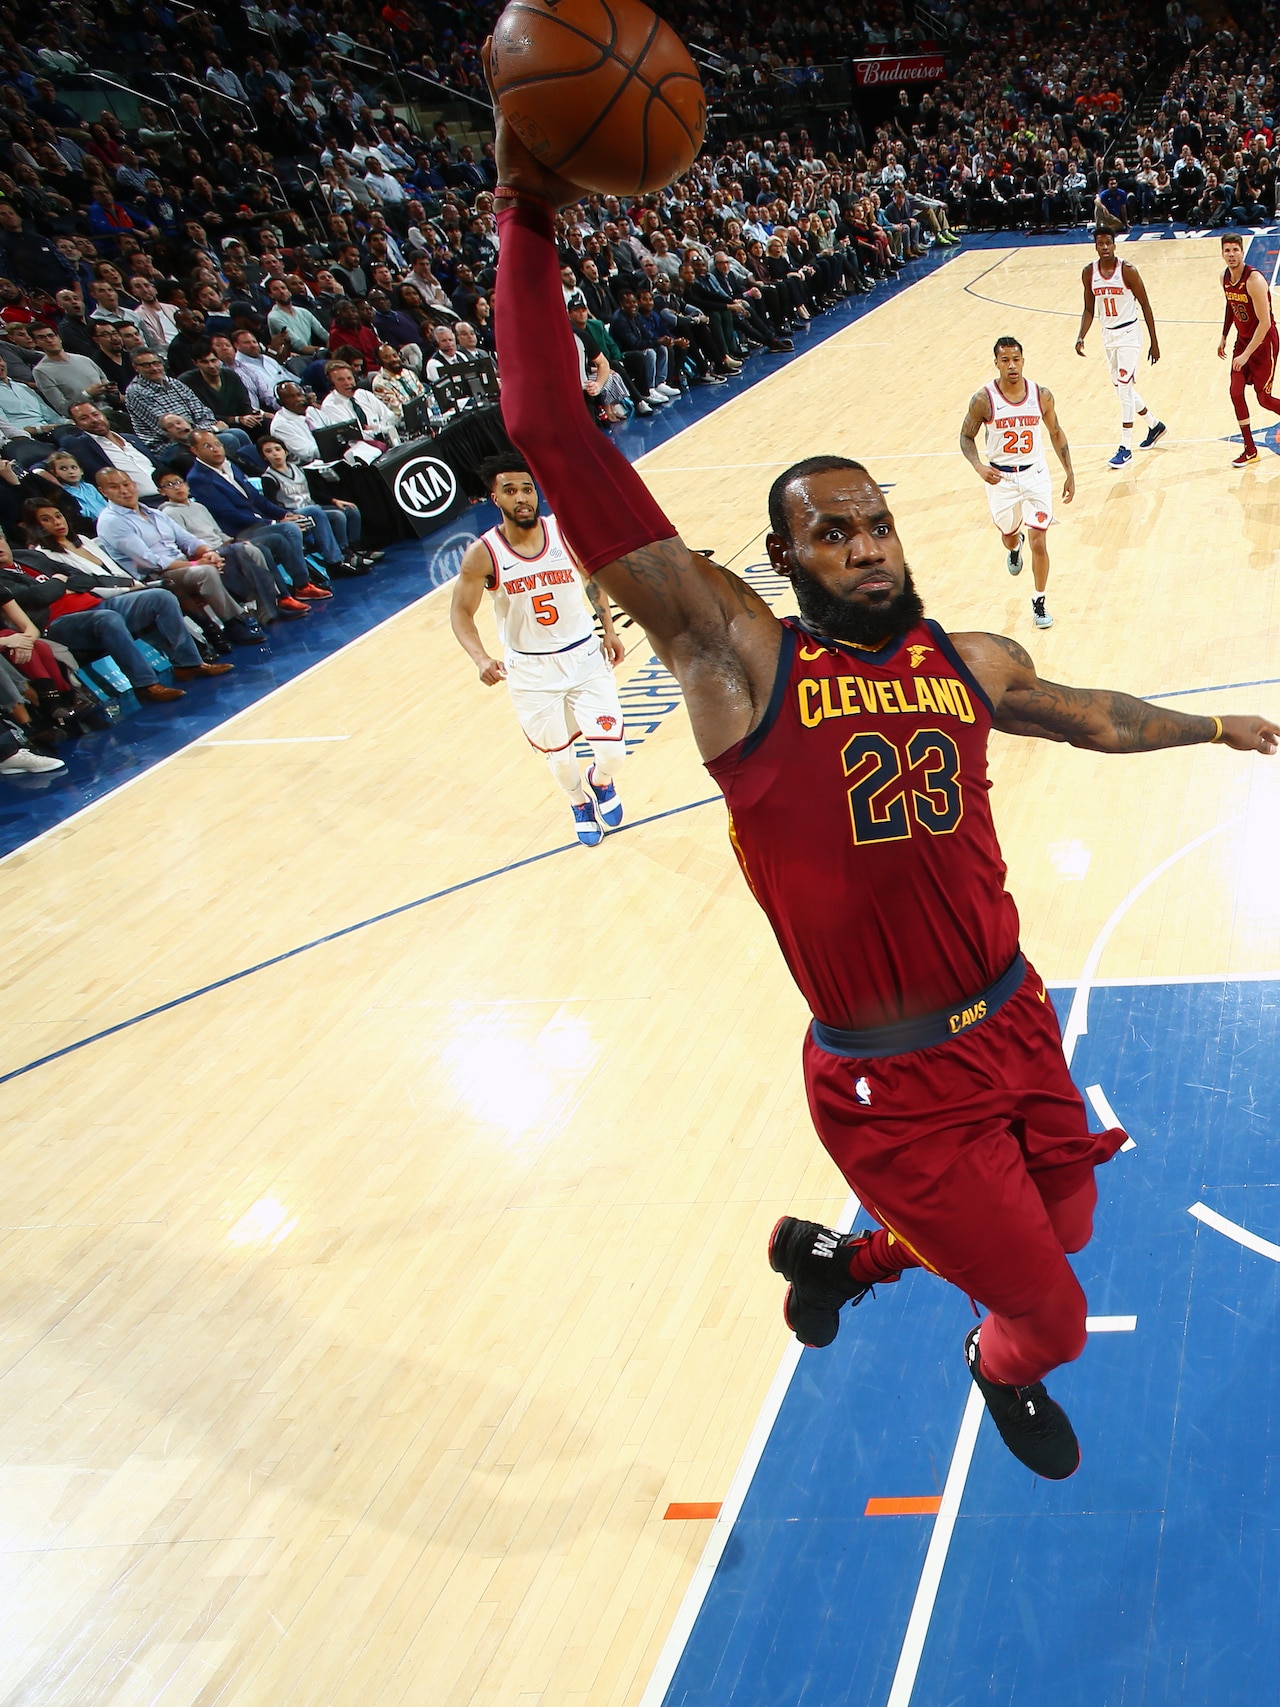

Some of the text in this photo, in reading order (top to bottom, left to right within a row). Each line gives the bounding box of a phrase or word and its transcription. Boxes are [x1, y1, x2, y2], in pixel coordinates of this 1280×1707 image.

[857, 61, 944, 84] Budweiser
[1103, 298, 1118, 317] 11
[994, 416, 1041, 429] NEW YORK
[1003, 430, 1034, 454] 23
[400, 465, 452, 511] KIA
[503, 569, 576, 595] NEW YORK
[531, 592, 560, 627] 5
[796, 675, 977, 730] CLEVELAND
[840, 727, 965, 846] 23
[947, 999, 989, 1034] CAVS
